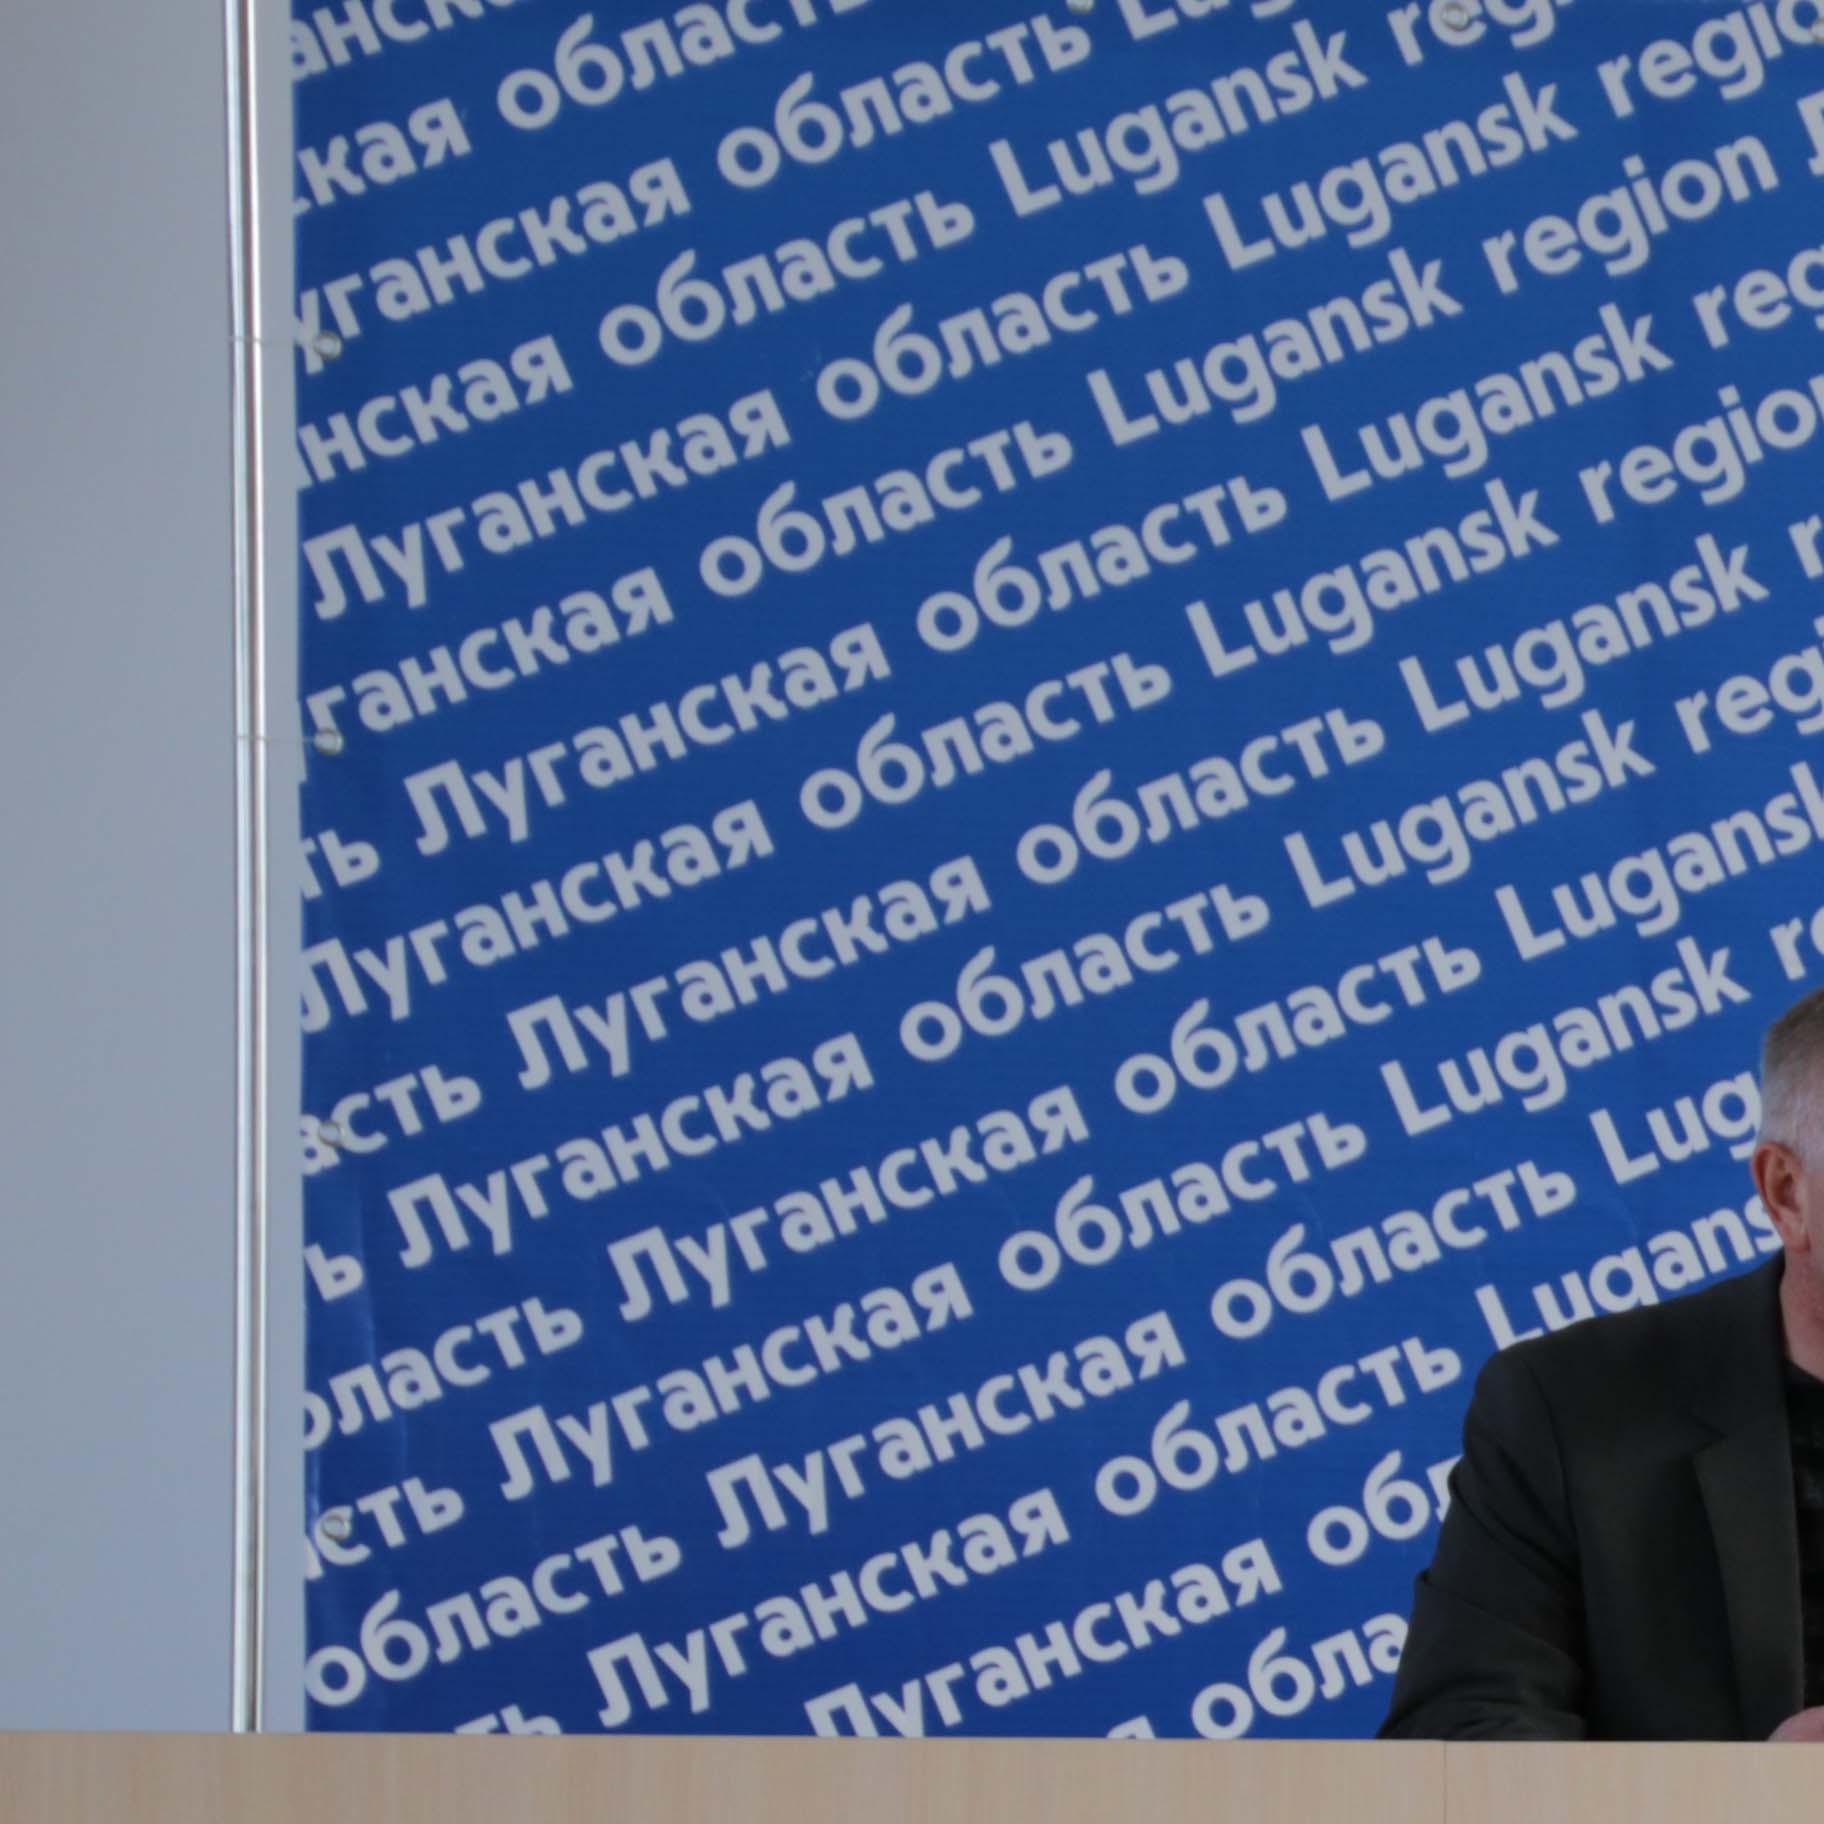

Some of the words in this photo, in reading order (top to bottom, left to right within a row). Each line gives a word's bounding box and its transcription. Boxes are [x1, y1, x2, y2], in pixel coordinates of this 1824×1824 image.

[303, 389, 790, 619] Луганская
[817, 245, 1189, 420] область
[1204, 72, 1577, 270] Lugansk
[599, 192, 975, 365] область
[989, 19, 1367, 216] Lugansk
[700, 422, 1072, 596] область
[1088, 248, 1462, 445] Lugansk
[1483, 136, 1778, 294] region
[717, 14, 1091, 188] область
[306, 800, 774, 1033] Луганская
[800, 653, 1171, 829] область
[1186, 478, 1559, 677] Lugansk
[404, 623, 891, 855] Луганская
[917, 476, 1287, 651] область
[1301, 303, 1673, 501] Lugansk
[507, 856, 991, 1089] Луганская
[1017, 709, 1385, 884] область
[1399, 533, 1769, 731] Lugansk
[388, 1033, 873, 1268] Луганская
[900, 884, 1270, 1062] область
[1284, 709, 1655, 908] Lugansk
[490, 1263, 973, 1500] Луганская
[998, 1113, 1367, 1290] область
[1381, 936, 1750, 1135] Lugansk
[608, 1085, 1089, 1321] Луганская
[1115, 937, 1481, 1114] область
[309, 1526, 682, 1707] область
[706, 1311, 1186, 1549] Луганская
[1211, 1161, 1576, 1339] область
[587, 1488, 1070, 1728] Луганская
[1095, 1337, 1461, 1516] область
[804, 1539, 1282, 1736] Луганская
